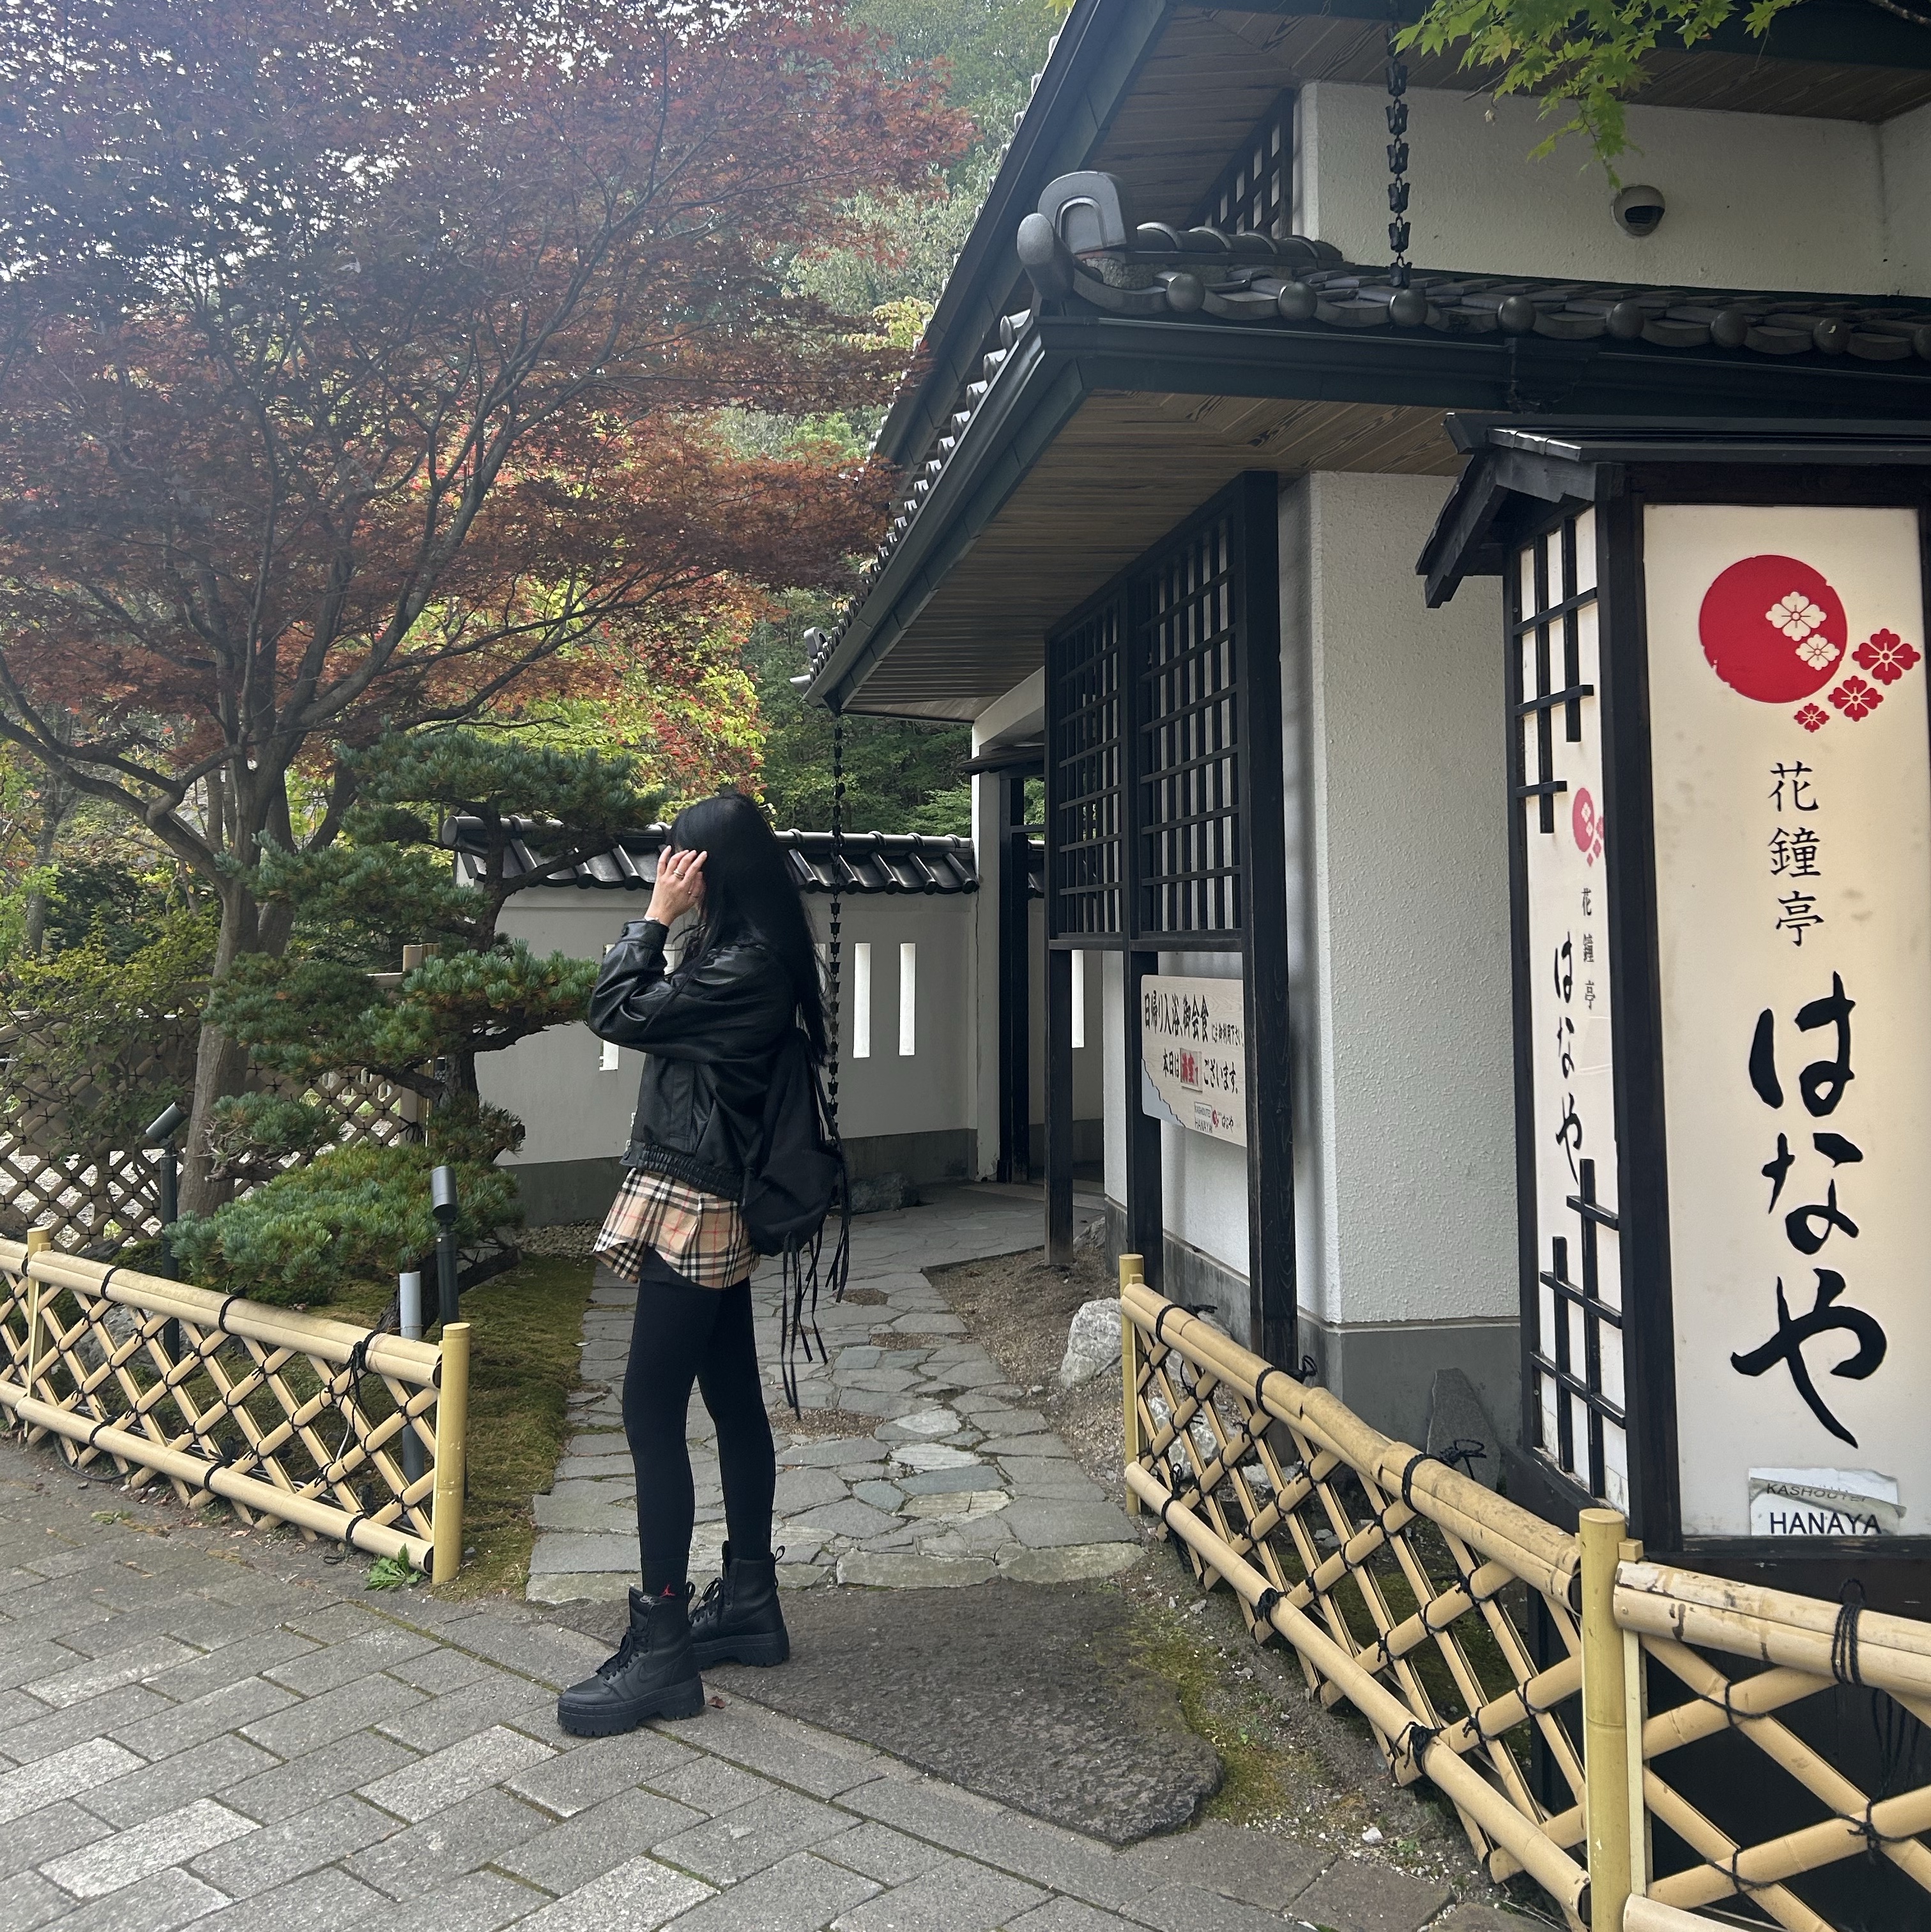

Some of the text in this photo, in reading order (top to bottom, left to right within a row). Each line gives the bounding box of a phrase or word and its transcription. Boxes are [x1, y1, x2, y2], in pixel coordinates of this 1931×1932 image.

[1767, 760, 1825, 947] 花鐘亭
[1555, 931, 1583, 1185] はなや
[1729, 971, 1888, 1449] はなや
[1770, 1512, 1882, 1535] HANAYA
